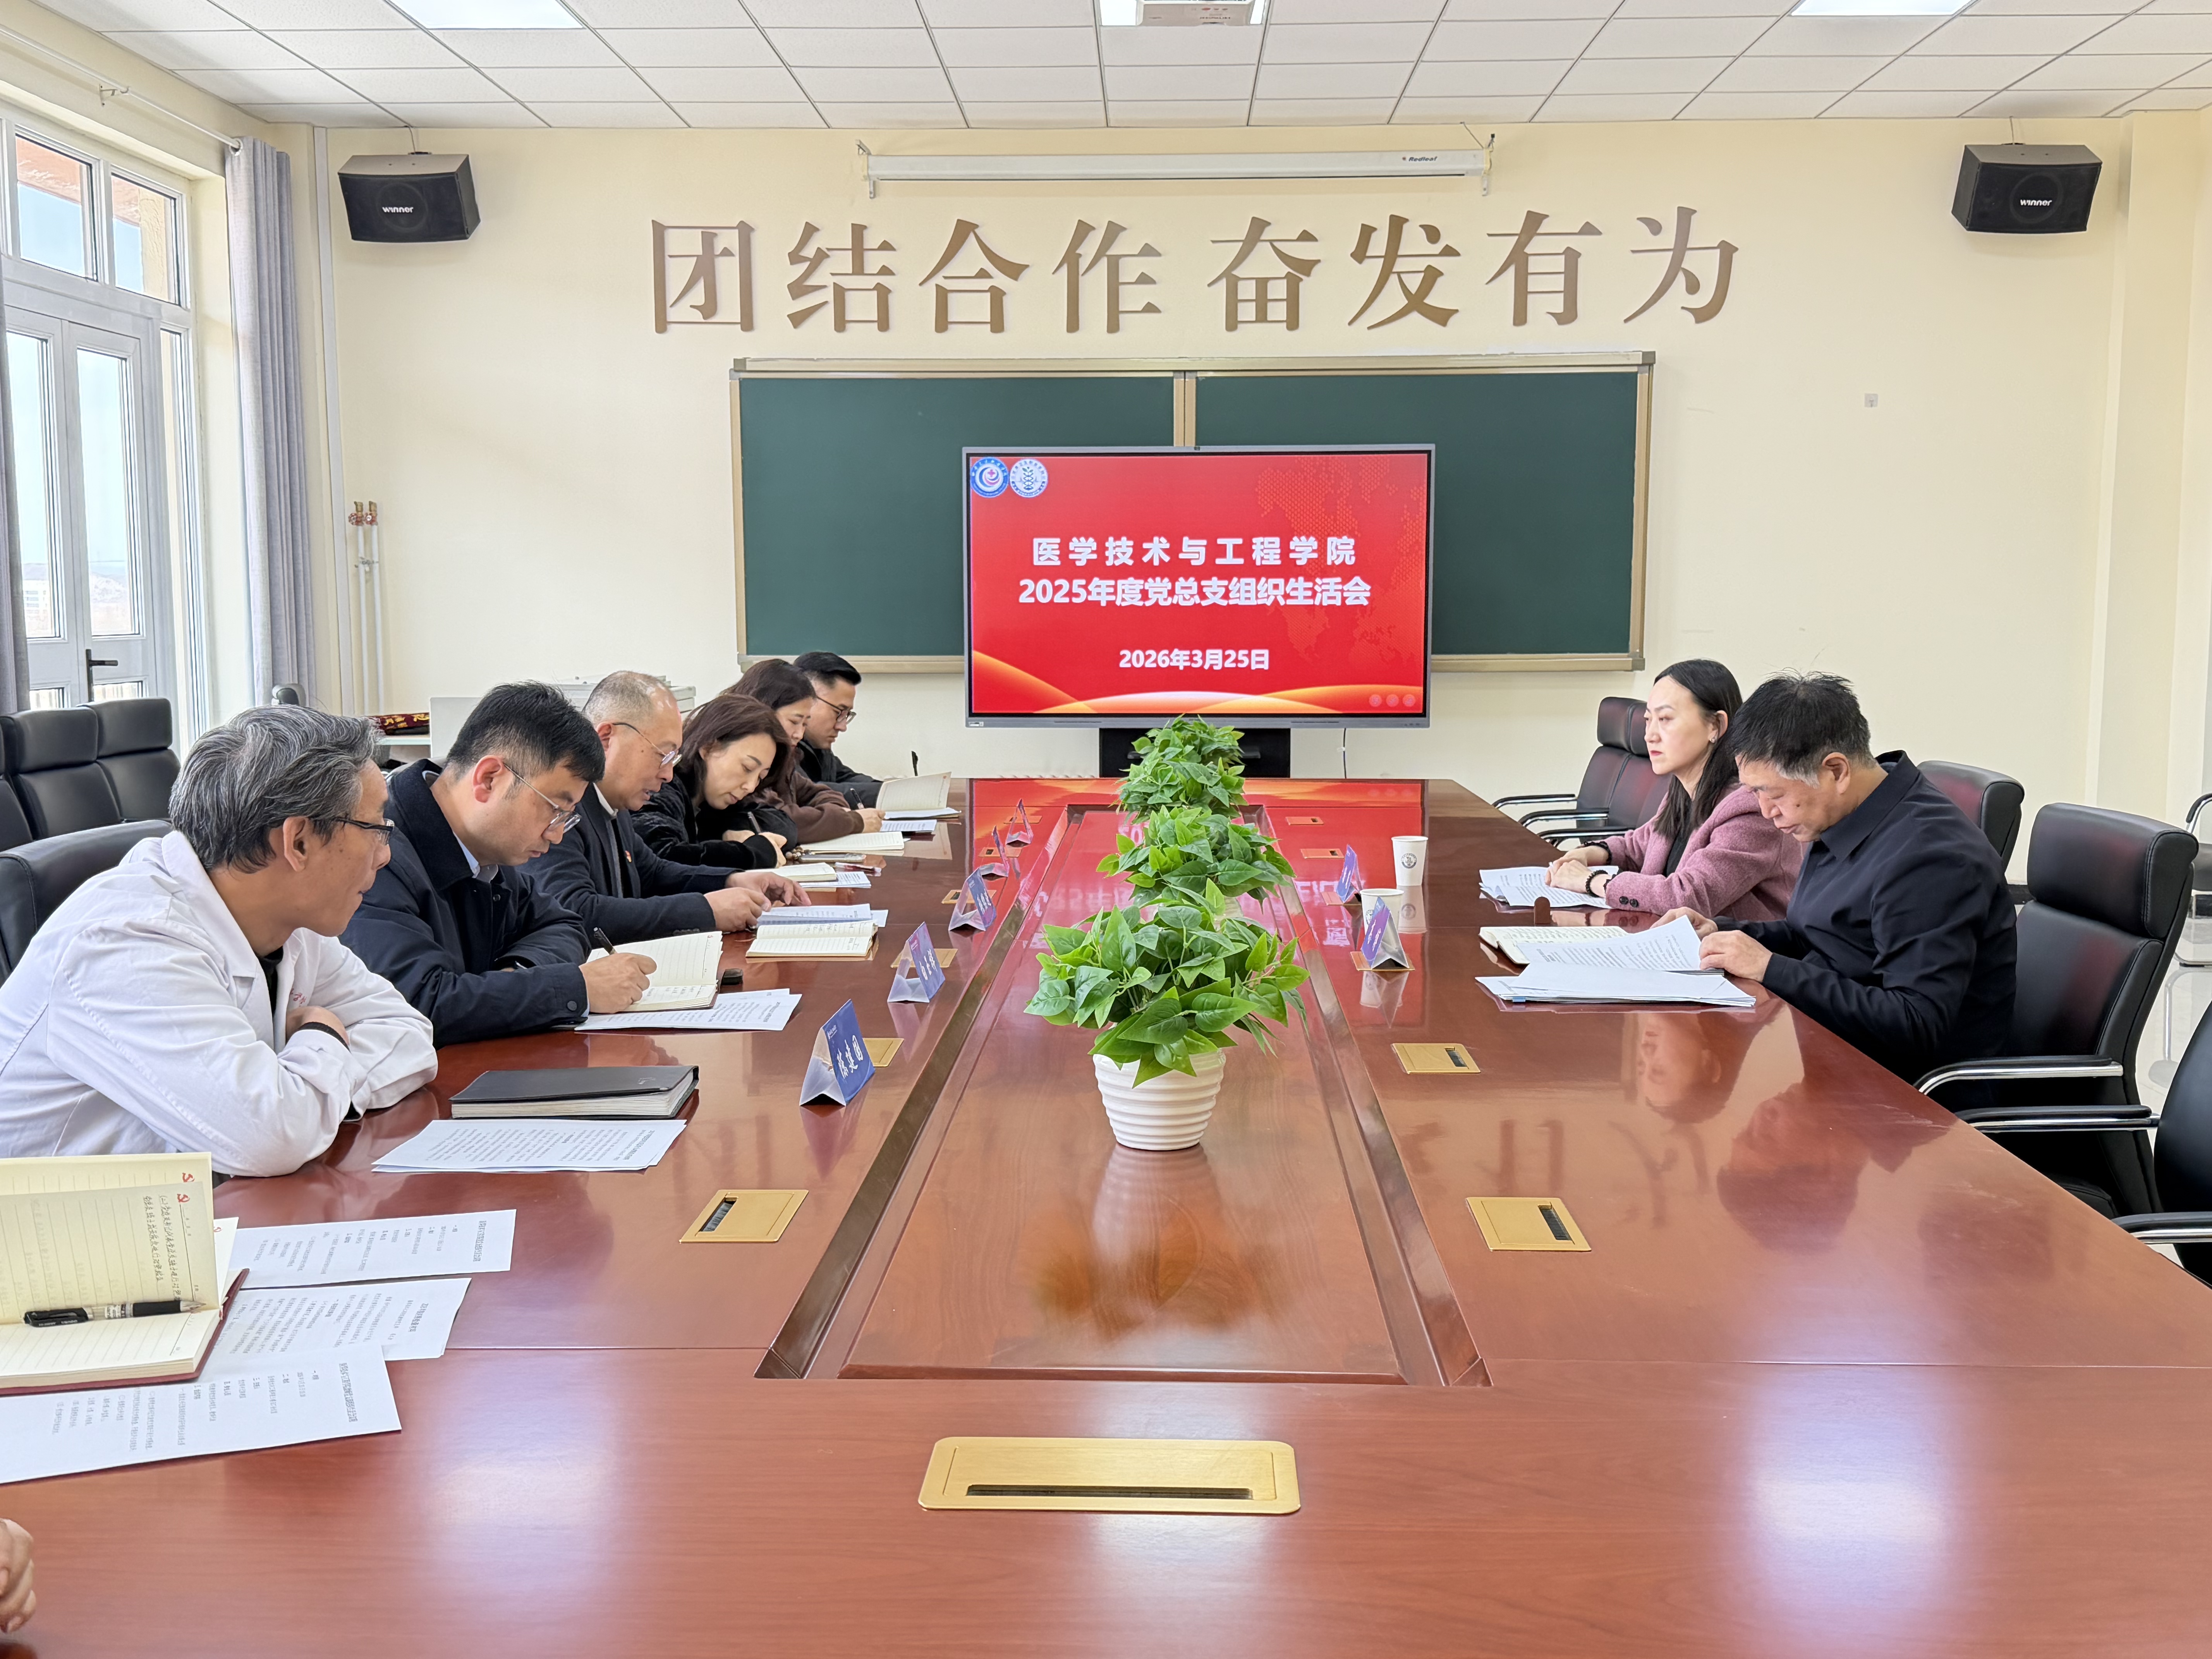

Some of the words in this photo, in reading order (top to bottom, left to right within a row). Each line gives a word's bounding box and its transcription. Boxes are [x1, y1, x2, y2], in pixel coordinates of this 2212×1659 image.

[651, 218, 1162, 335] 团结合作
[1207, 206, 1739, 331] 奋发有为
[1032, 536, 1356, 566] 医学技术与工程学院
[1018, 576, 1372, 607] 2025年度党总支组织生活会
[1119, 648, 1270, 670] 2026年3月25日
